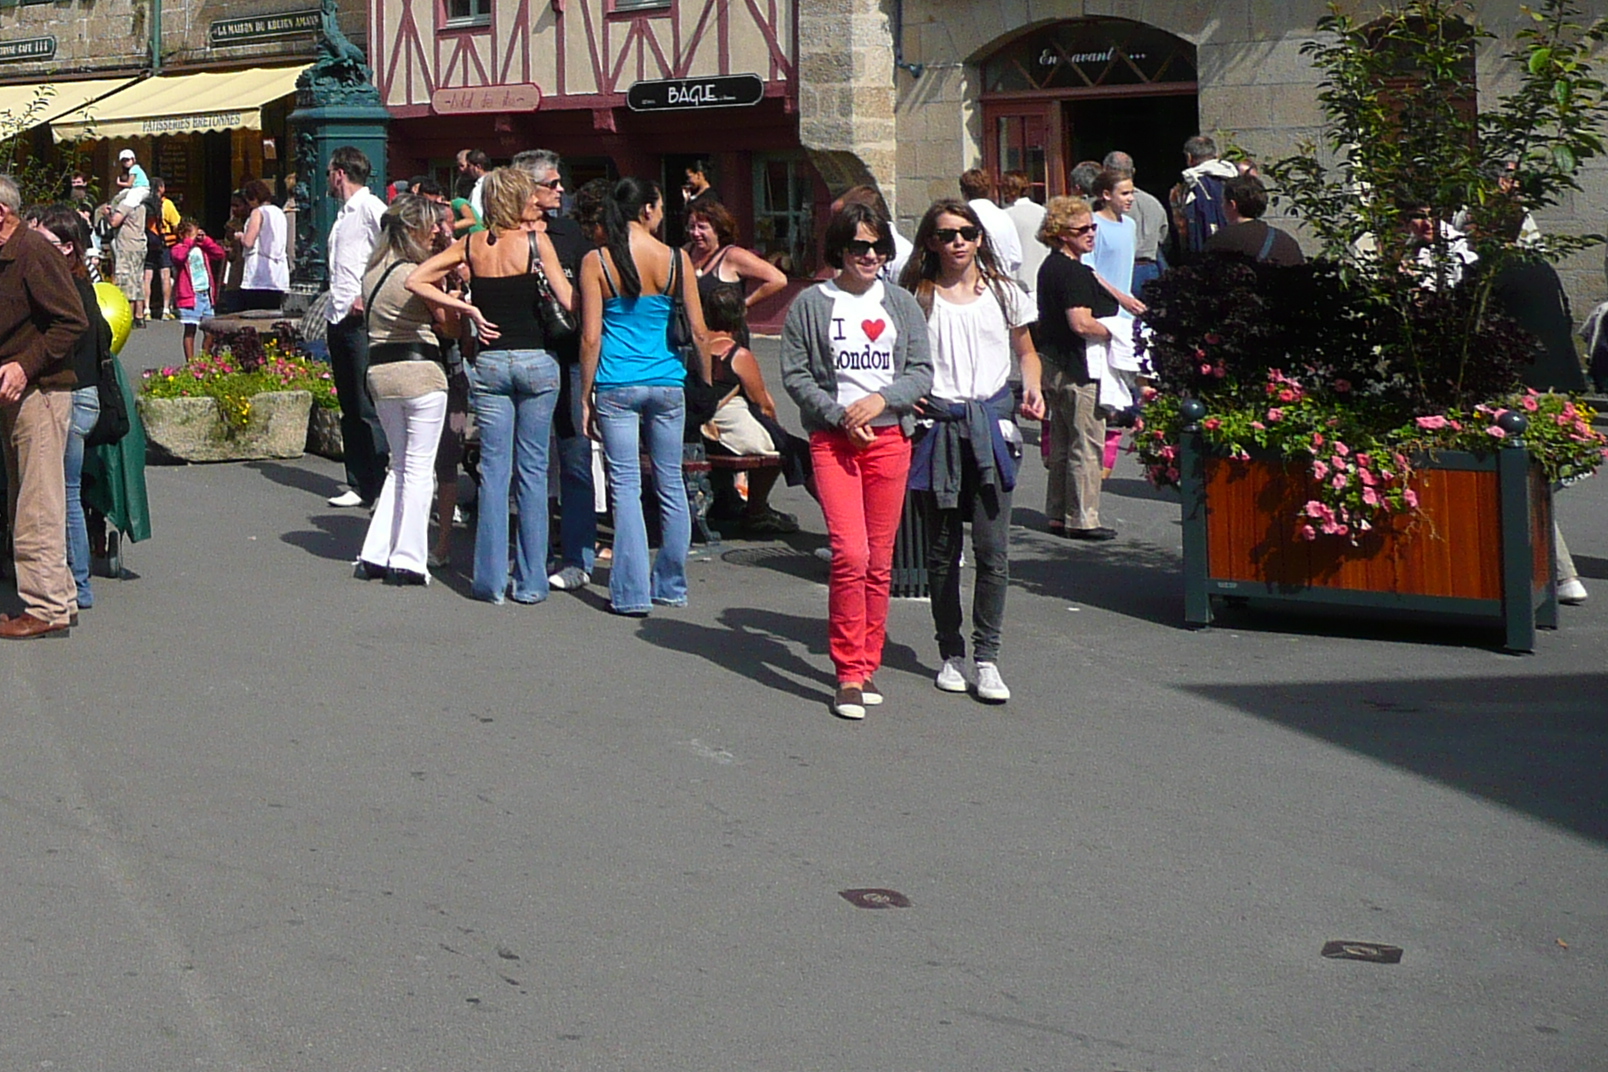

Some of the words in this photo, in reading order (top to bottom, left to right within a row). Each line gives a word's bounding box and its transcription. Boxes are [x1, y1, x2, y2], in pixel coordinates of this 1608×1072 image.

[1039, 49, 1057, 65] En
[1072, 46, 1114, 63] avant
[142, 117, 191, 132] PATISSERIES
[192, 112, 241, 128] BRETONNES
[832, 318, 846, 340] I
